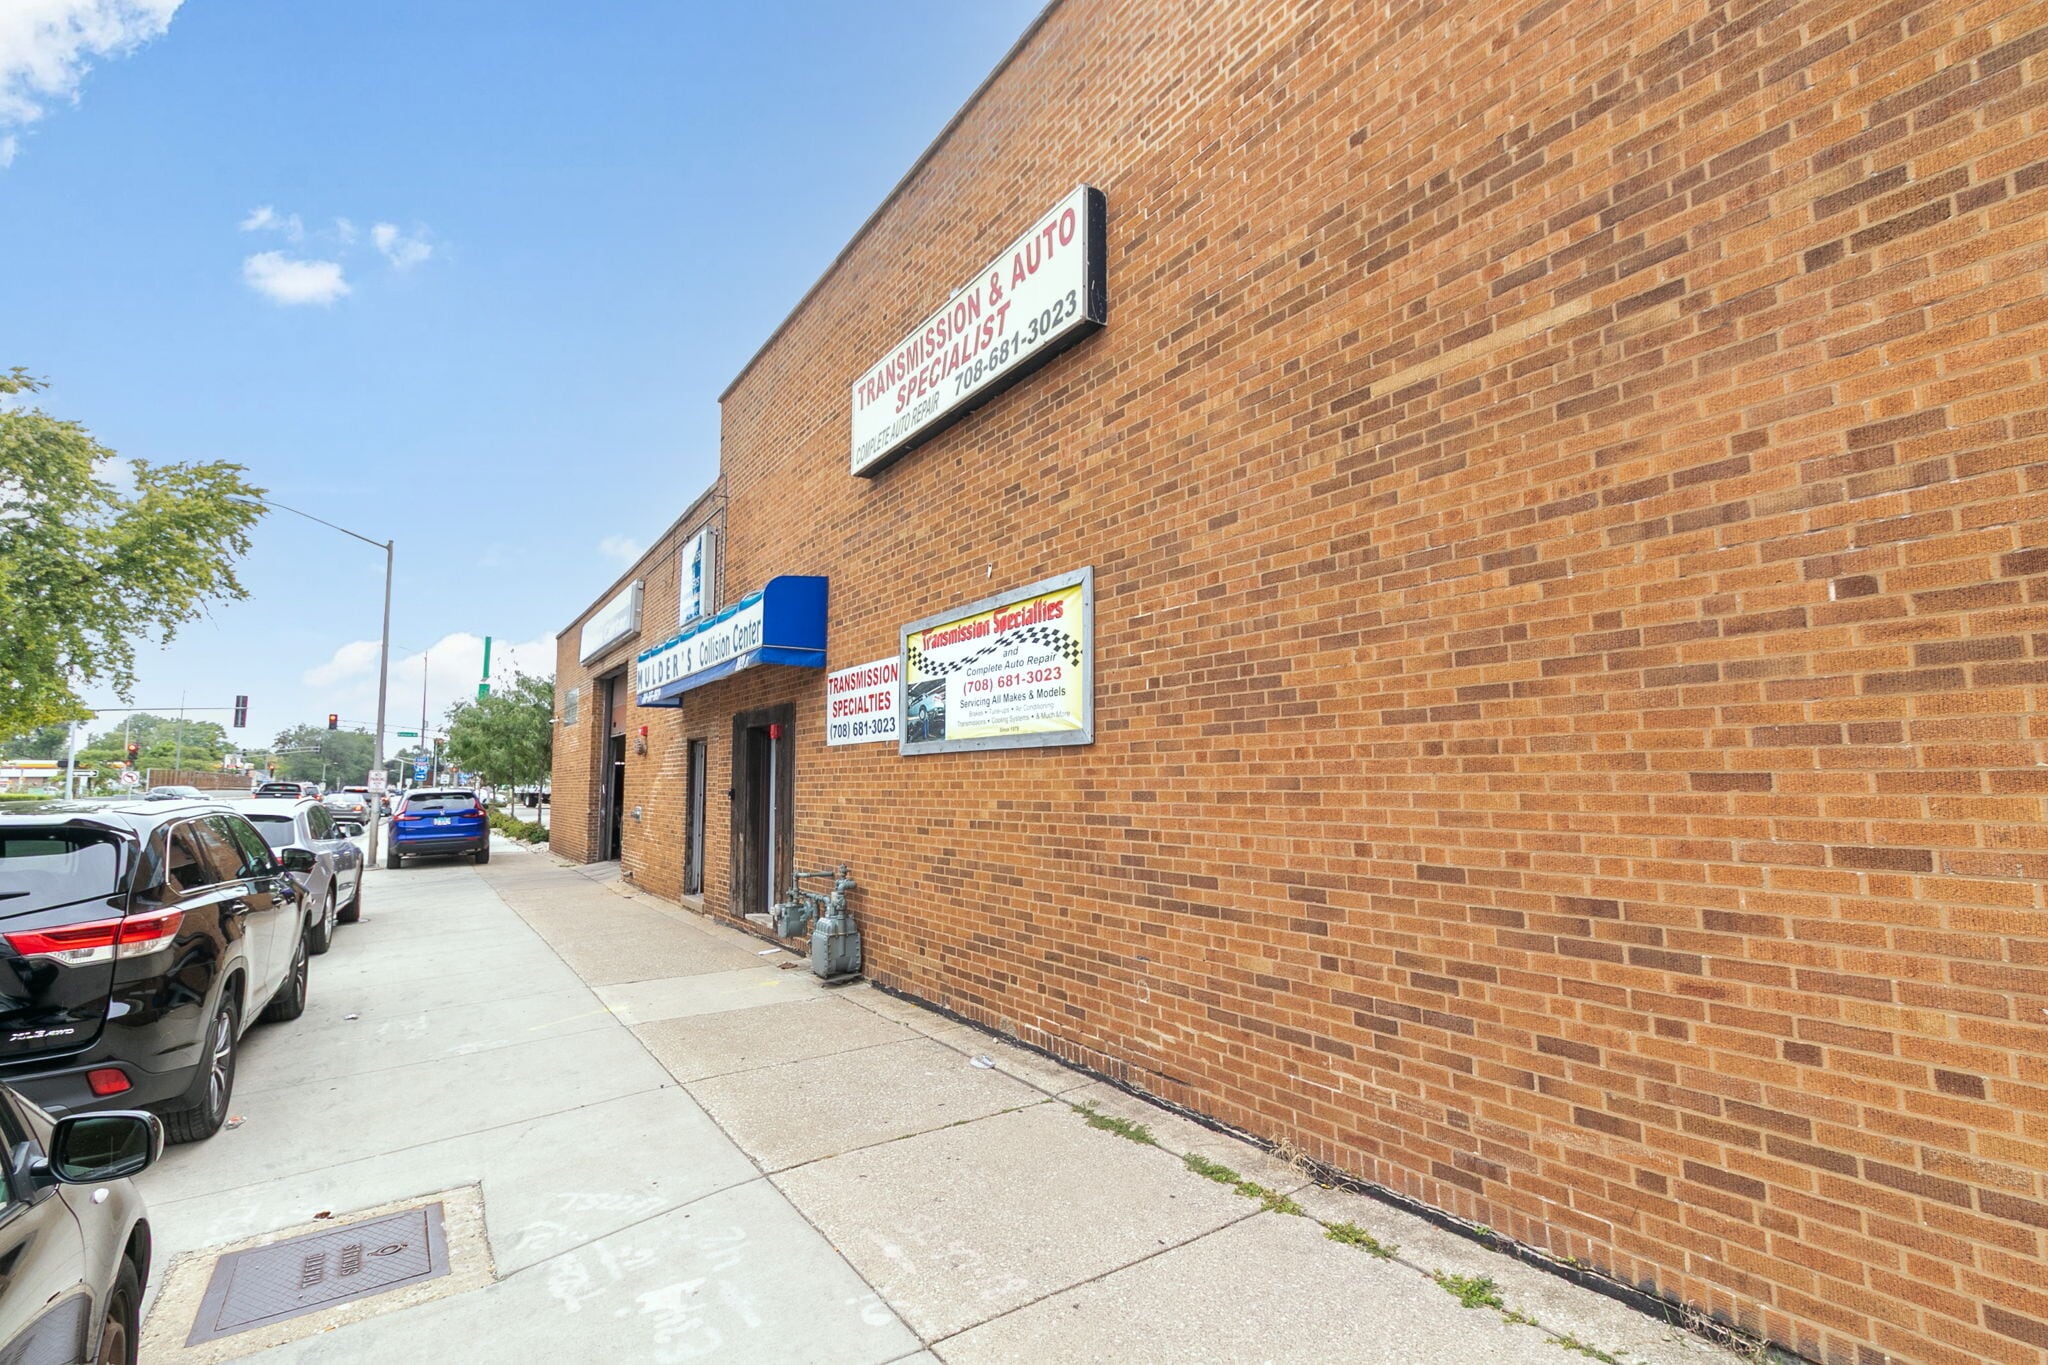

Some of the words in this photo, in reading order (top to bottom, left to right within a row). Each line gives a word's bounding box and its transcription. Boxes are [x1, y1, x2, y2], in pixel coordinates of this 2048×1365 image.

[858, 288, 981, 411] TRANSMISSION
[989, 272, 1003, 306] &
[1011, 207, 1076, 290] AUTO
[896, 300, 1011, 414] SPECIALIST
[955, 289, 1077, 396] 708-681-3023
[857, 426, 891, 464] COMPLETE
[890, 412, 910, 440] AUTO
[911, 391, 939, 427] REPAIR
[921, 620, 990, 651] Transmission
[993, 599, 1064, 636] Specialties
[638, 648, 691, 690] MULDER'S
[700, 632, 730, 666] Collision
[733, 618, 761, 652] Center
[966, 663, 1003, 677] Complete
[1004, 659, 1024, 669] Auto
[1027, 652, 1057, 666] Repair
[1003, 646, 1019, 657] and
[829, 663, 898, 695] TRANSMISSION
[963, 678, 993, 696] (708)
[997, 666, 1062, 688] 681-3023
[833, 691, 891, 718] SPECIALTIES
[960, 696, 991, 708] Servicing
[991, 695, 1002, 704] All
[1003, 691, 1026, 702] Makes
[1029, 690, 1034, 699] &
[1037, 686, 1066, 698] Models
[830, 722, 850, 739] (708)
[853, 717, 896, 736] 681-3023
[9, 1030, 45, 1041] XLE
[302, 1253, 325, 1288] TRAFFIC
